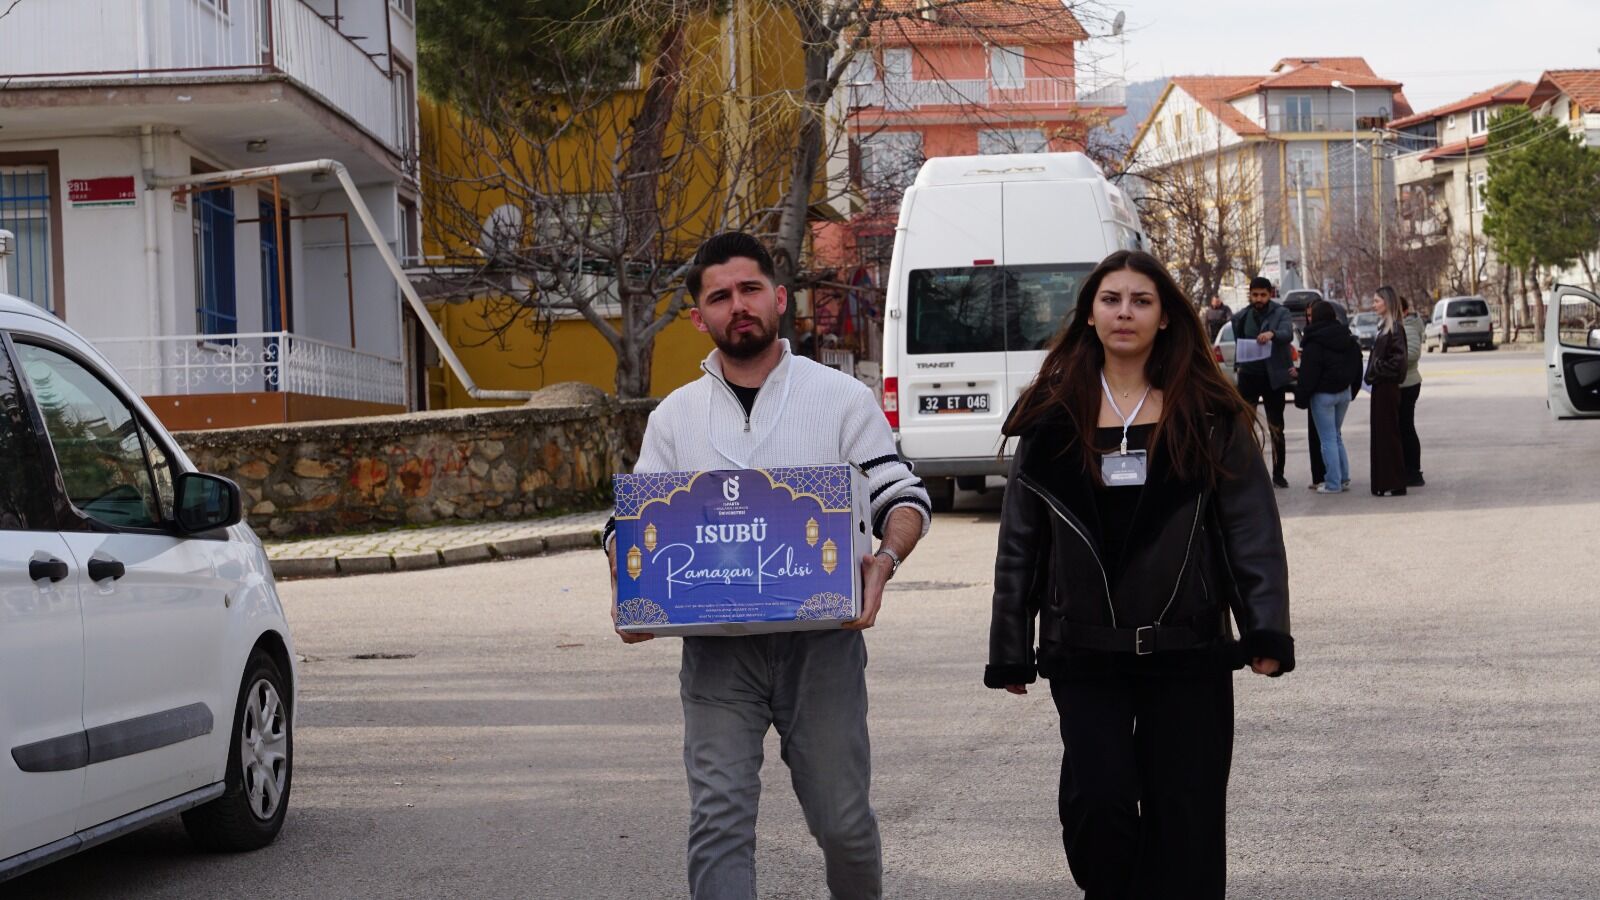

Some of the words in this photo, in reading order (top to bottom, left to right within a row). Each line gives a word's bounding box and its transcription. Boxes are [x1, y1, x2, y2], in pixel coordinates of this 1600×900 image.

[917, 361, 955, 369] TRANSIT
[925, 397, 939, 410] 32
[947, 396, 961, 409] ET
[967, 395, 987, 409] 046
[695, 517, 768, 544] ISUBÜ
[651, 543, 754, 599] Ramazan
[758, 543, 813, 594] Kolisi
